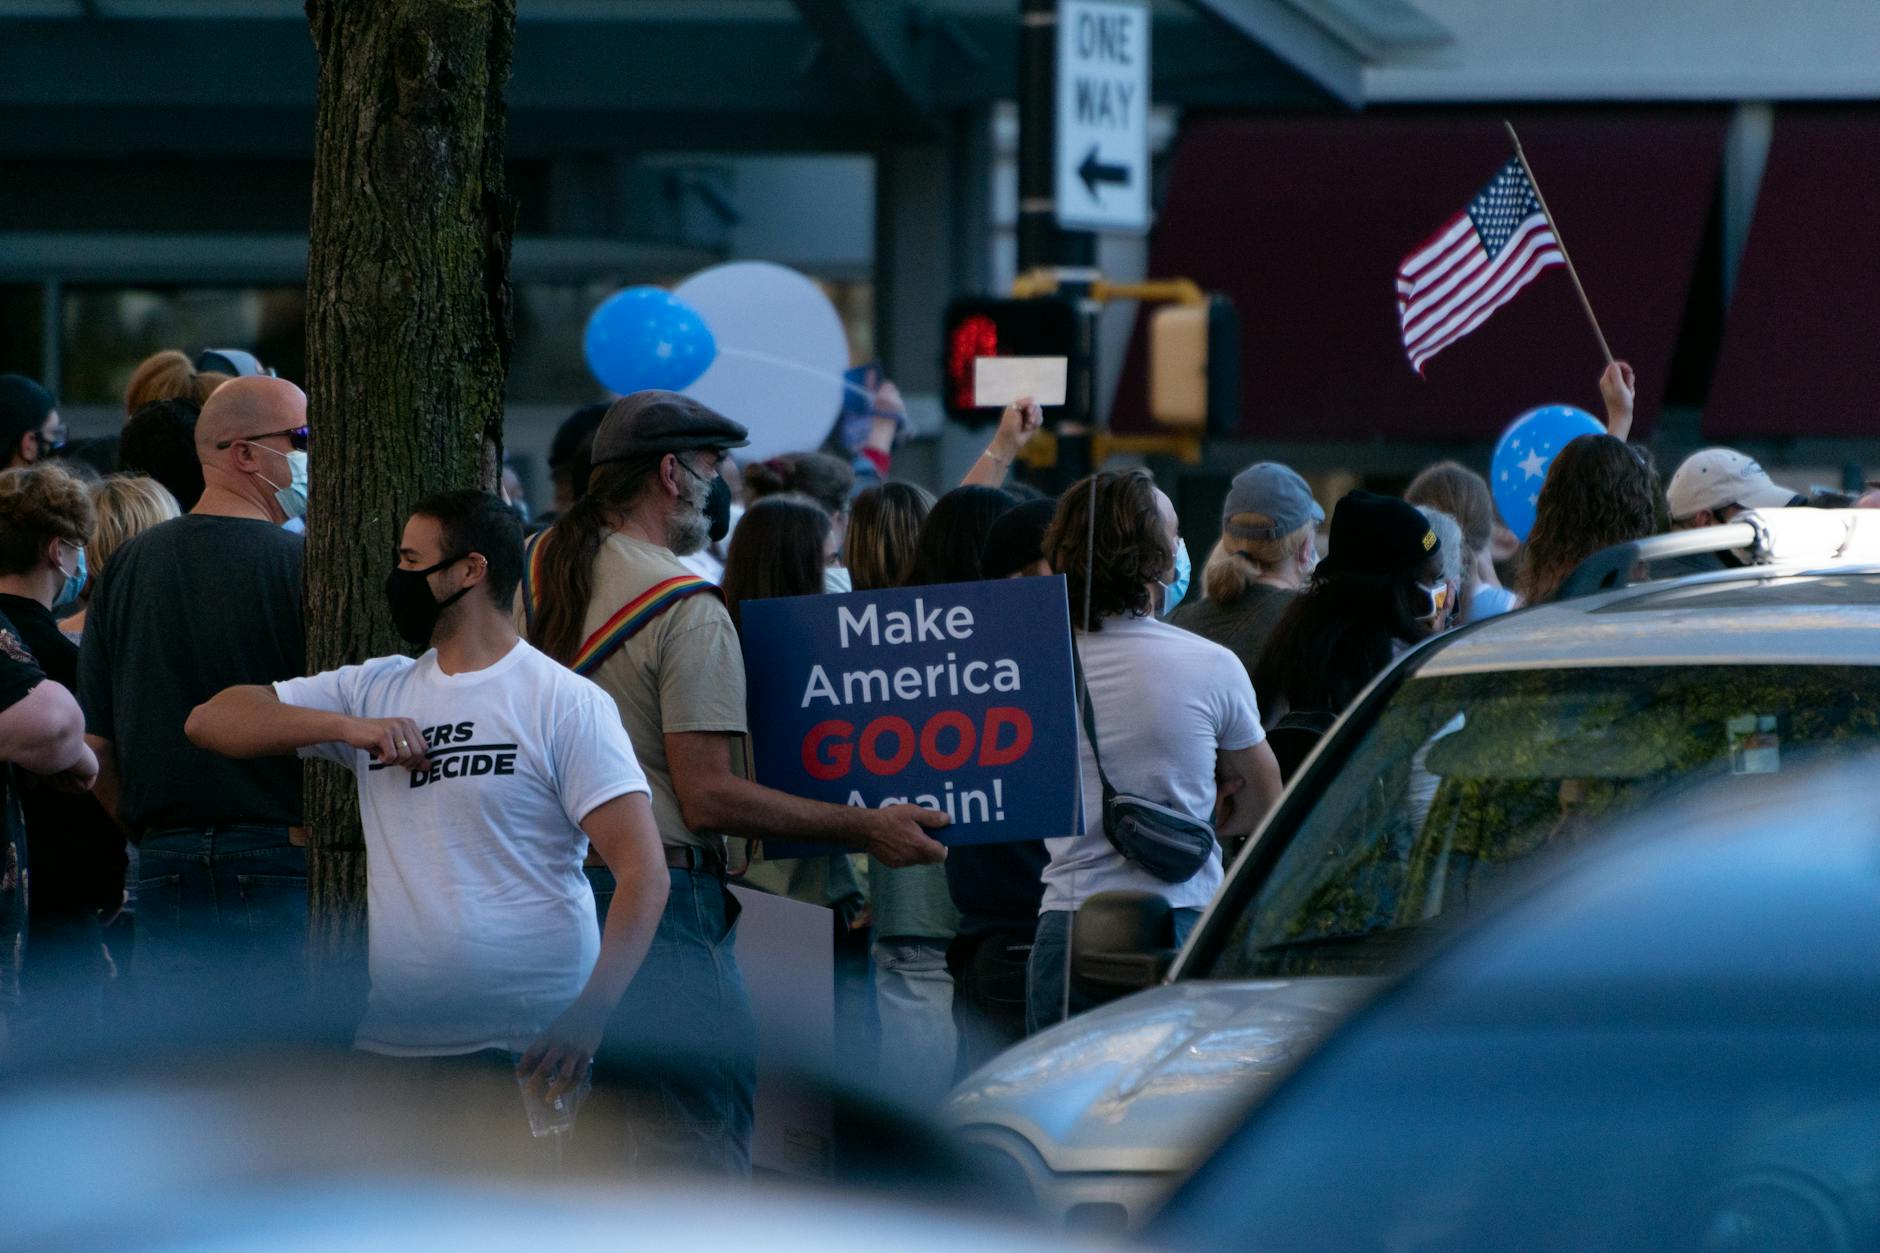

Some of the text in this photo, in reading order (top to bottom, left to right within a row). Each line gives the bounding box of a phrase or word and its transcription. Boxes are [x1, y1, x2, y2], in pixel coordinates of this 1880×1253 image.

[1077, 12, 1133, 65] ONE
[1074, 77, 1136, 132] WAY
[837, 598, 975, 649] Make
[800, 652, 1022, 708] America
[422, 721, 475, 749] ERS
[801, 706, 1034, 781] GOOD
[410, 753, 517, 789] DECIDE
